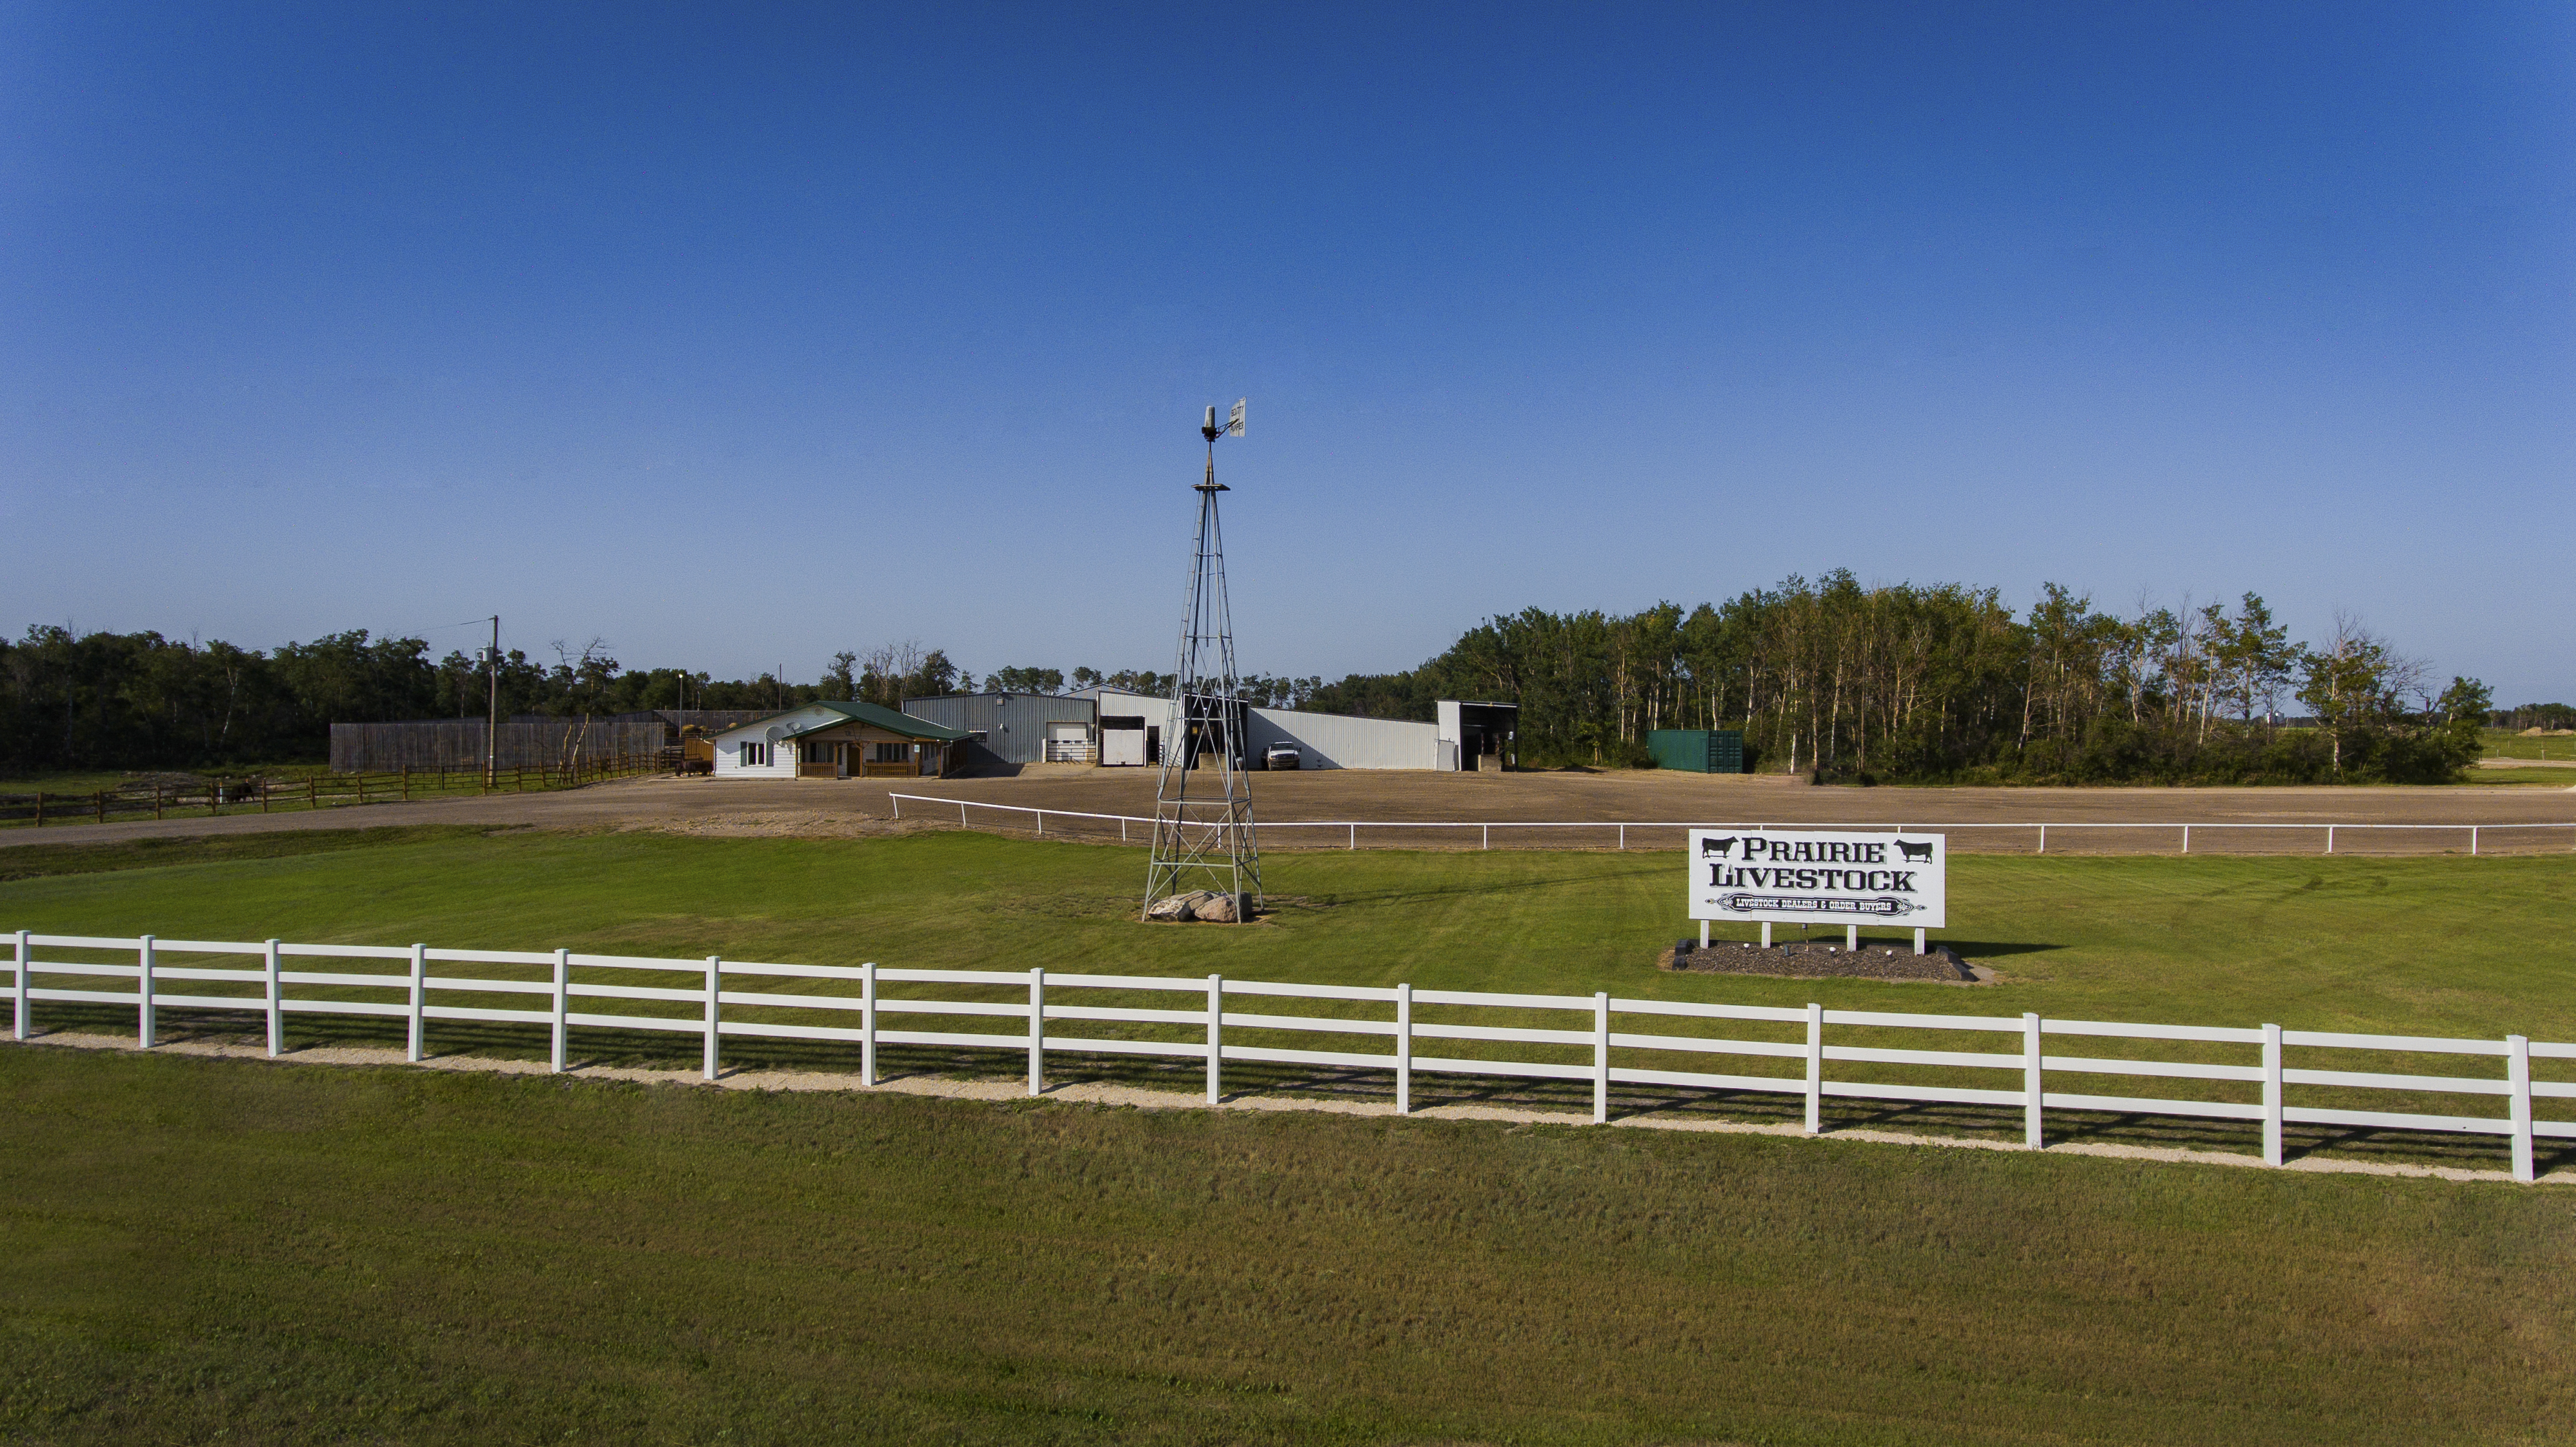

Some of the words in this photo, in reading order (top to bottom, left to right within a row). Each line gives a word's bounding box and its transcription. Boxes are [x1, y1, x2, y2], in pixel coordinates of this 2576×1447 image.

[1741, 837, 1886, 864] PRAIRIE
[1709, 863, 1917, 892] LIVESTOCK
[1736, 898, 1779, 908] LIVESTOCK
[1781, 900, 1818, 909] DEALERS
[1820, 900, 1827, 909] &
[1829, 901, 1857, 910] ORDER
[1859, 902, 1891, 911] BUYERS
